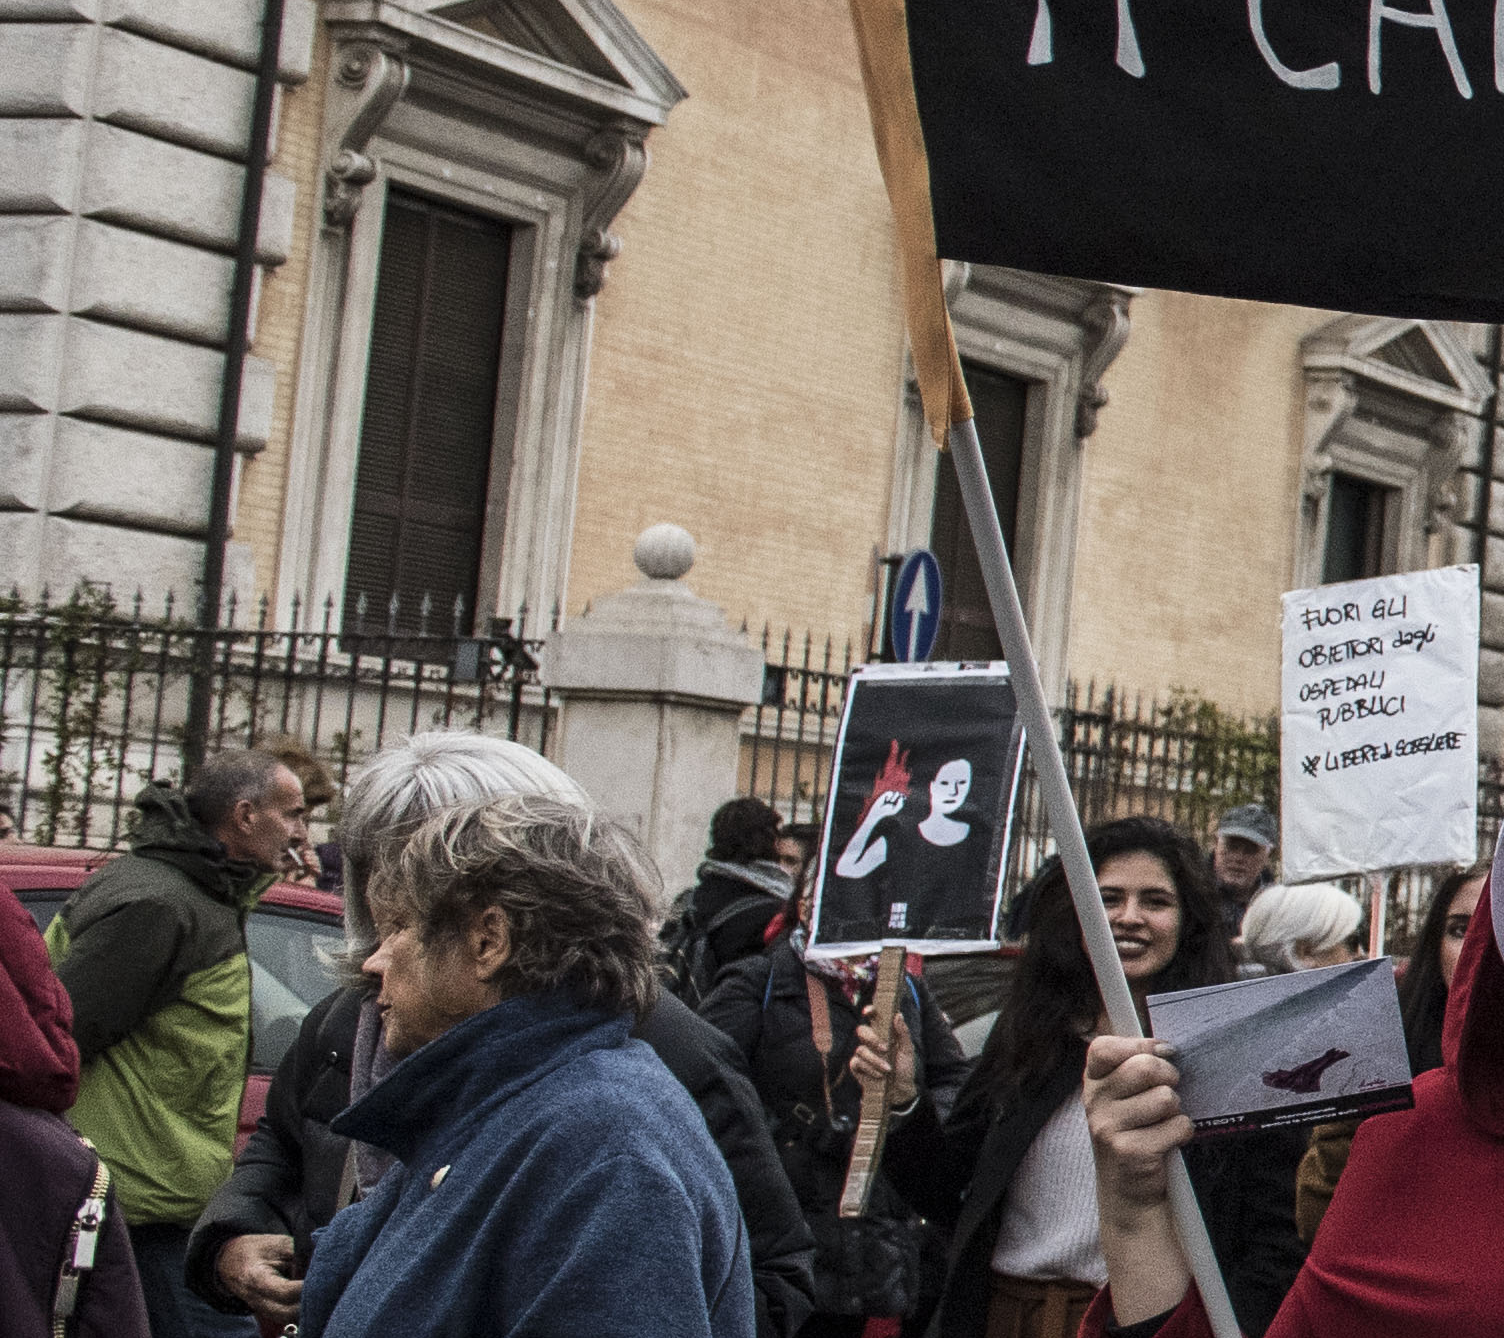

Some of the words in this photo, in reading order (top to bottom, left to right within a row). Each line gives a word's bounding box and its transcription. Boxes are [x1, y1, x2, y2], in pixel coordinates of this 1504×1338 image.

[1301, 603, 1361, 631] FUORI
[1371, 595, 1407, 620] GLI
[1299, 637, 1384, 668] OBIETTORI
[1299, 670, 1385, 702] OSPEDALI
[1317, 695, 1405, 730] PUBBLICI
